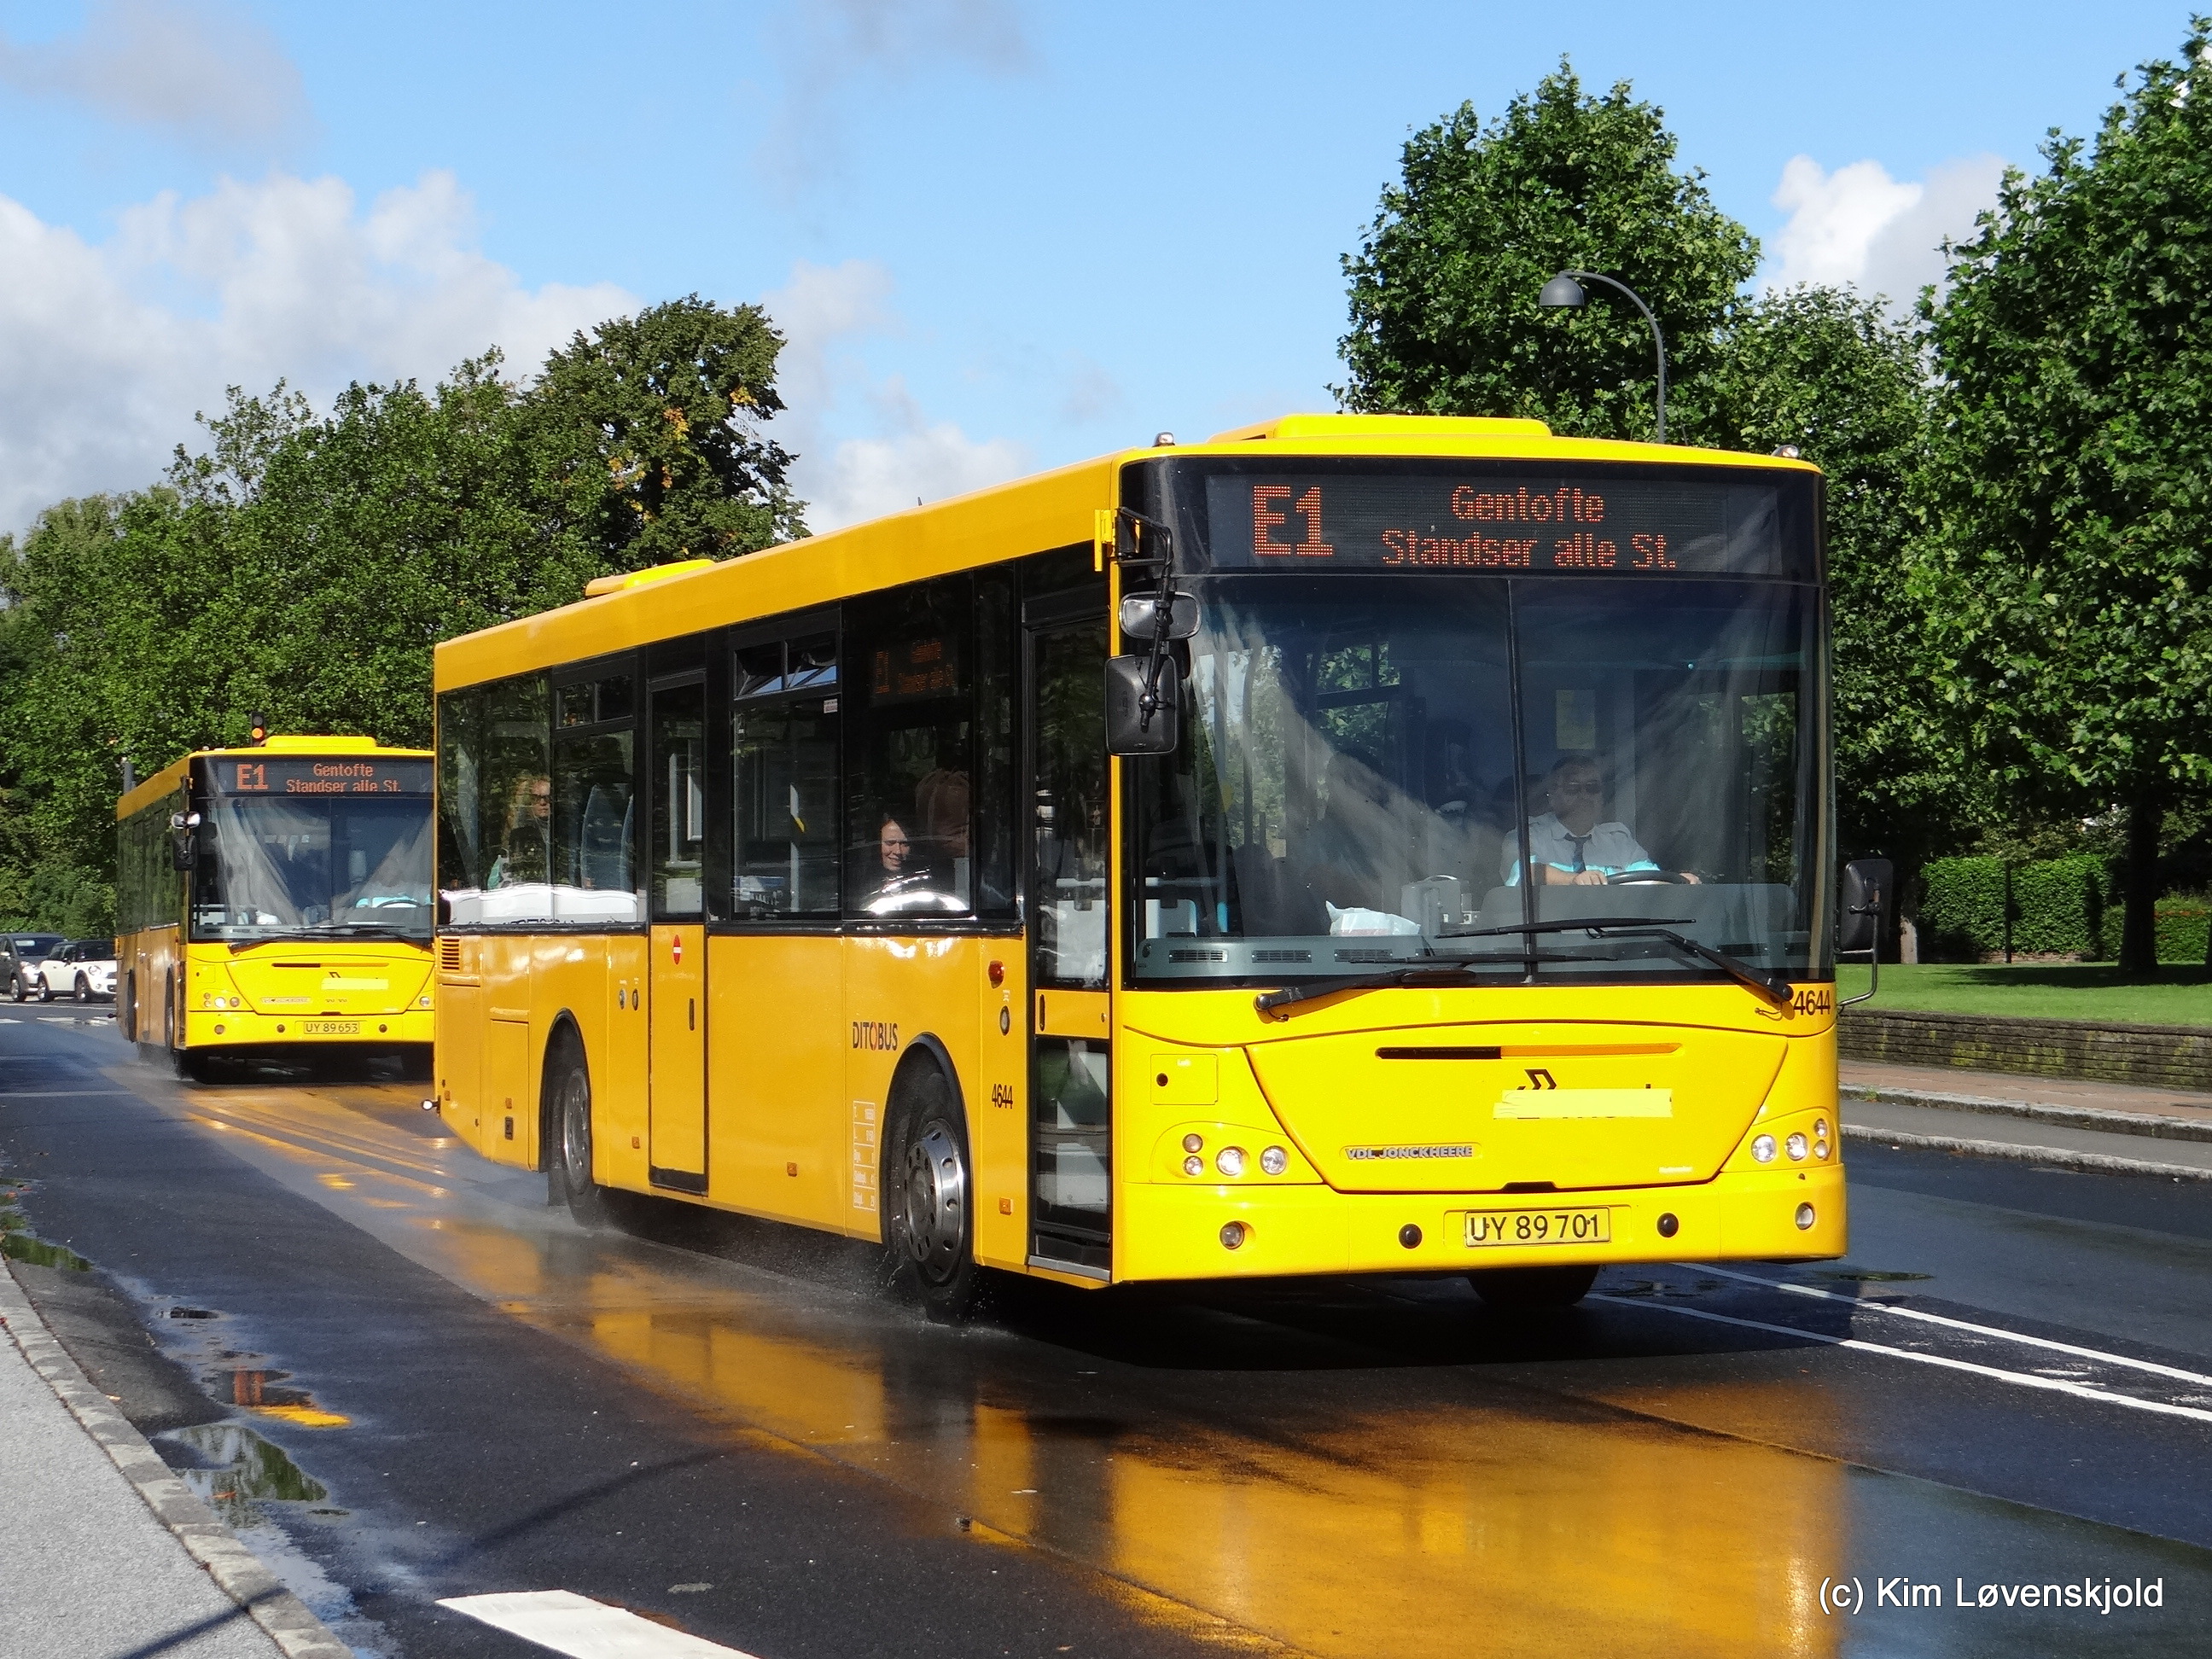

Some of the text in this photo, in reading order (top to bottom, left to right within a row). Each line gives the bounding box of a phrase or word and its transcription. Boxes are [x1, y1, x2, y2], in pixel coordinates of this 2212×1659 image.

[1452, 485, 1605, 522] Gentofte
[1251, 485, 1334, 557] E1
[1381, 528, 1678, 568] Standser alle St.
[236, 764, 269, 790] E1
[313, 763, 374, 777] Gentofte
[286, 779, 401, 793] Standser alle St.
[1793, 989, 1831, 1016] 4644
[306, 1022, 358, 1032] UY 89 653
[853, 1021, 899, 1051] DITOBUS
[992, 1083, 1014, 1109] 4644
[1345, 1145, 1473, 1160] VDL JONCKHEERE
[1470, 1214, 1598, 1241] UY 89 701
